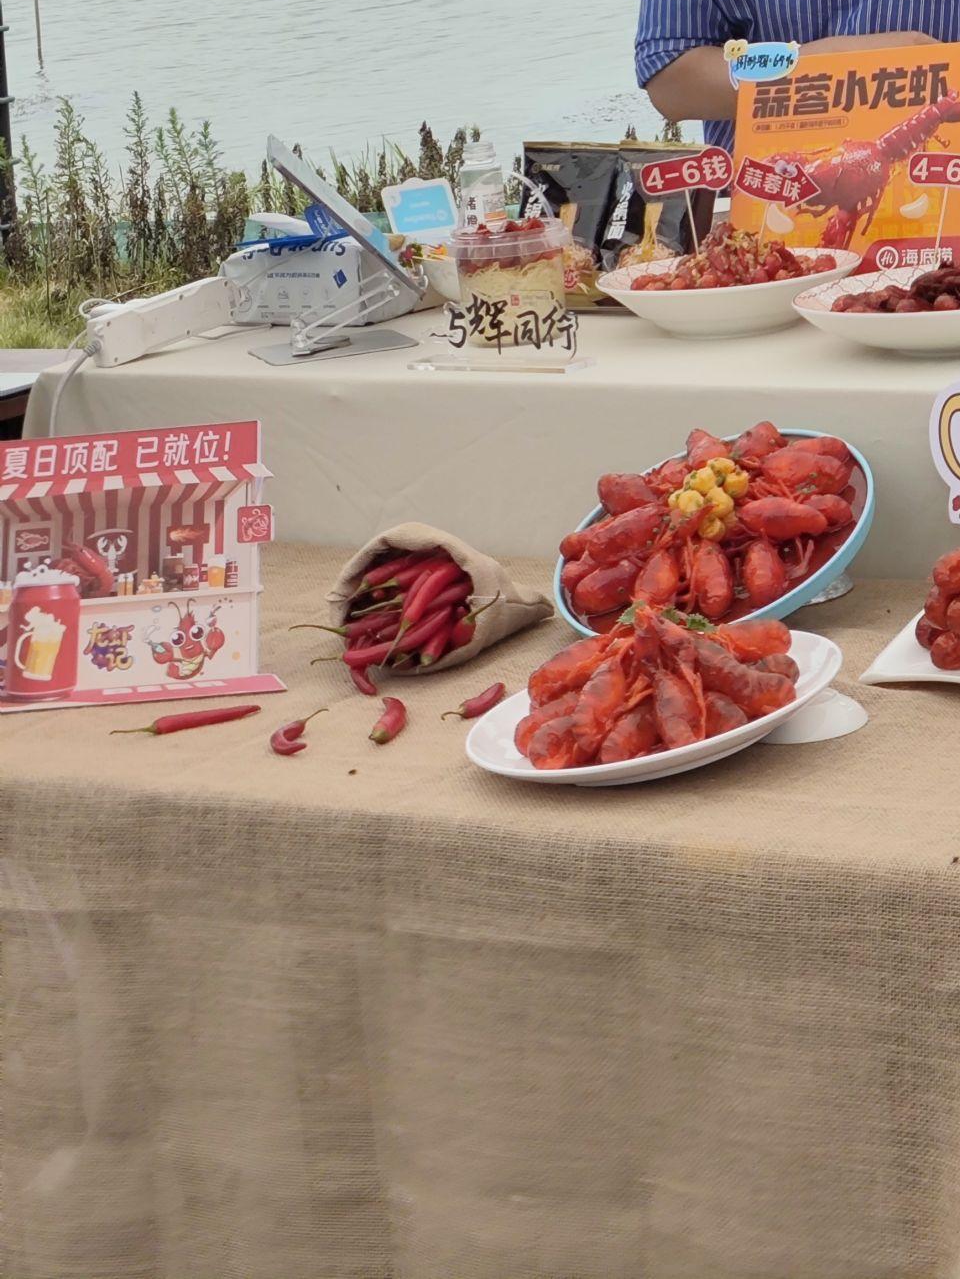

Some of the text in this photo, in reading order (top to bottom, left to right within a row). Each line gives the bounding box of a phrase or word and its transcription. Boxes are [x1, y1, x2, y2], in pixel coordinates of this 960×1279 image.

[753, 62, 950, 120] 蒜蓉小龙虾
[645, 154, 729, 190] 4-6钱
[743, 166, 803, 202] 蒜蓉味
[901, 247, 953, 266] 海底捞
[430, 292, 579, 359] 与辉同行
[2, 431, 231, 481] 夏日顶配 已就位!
